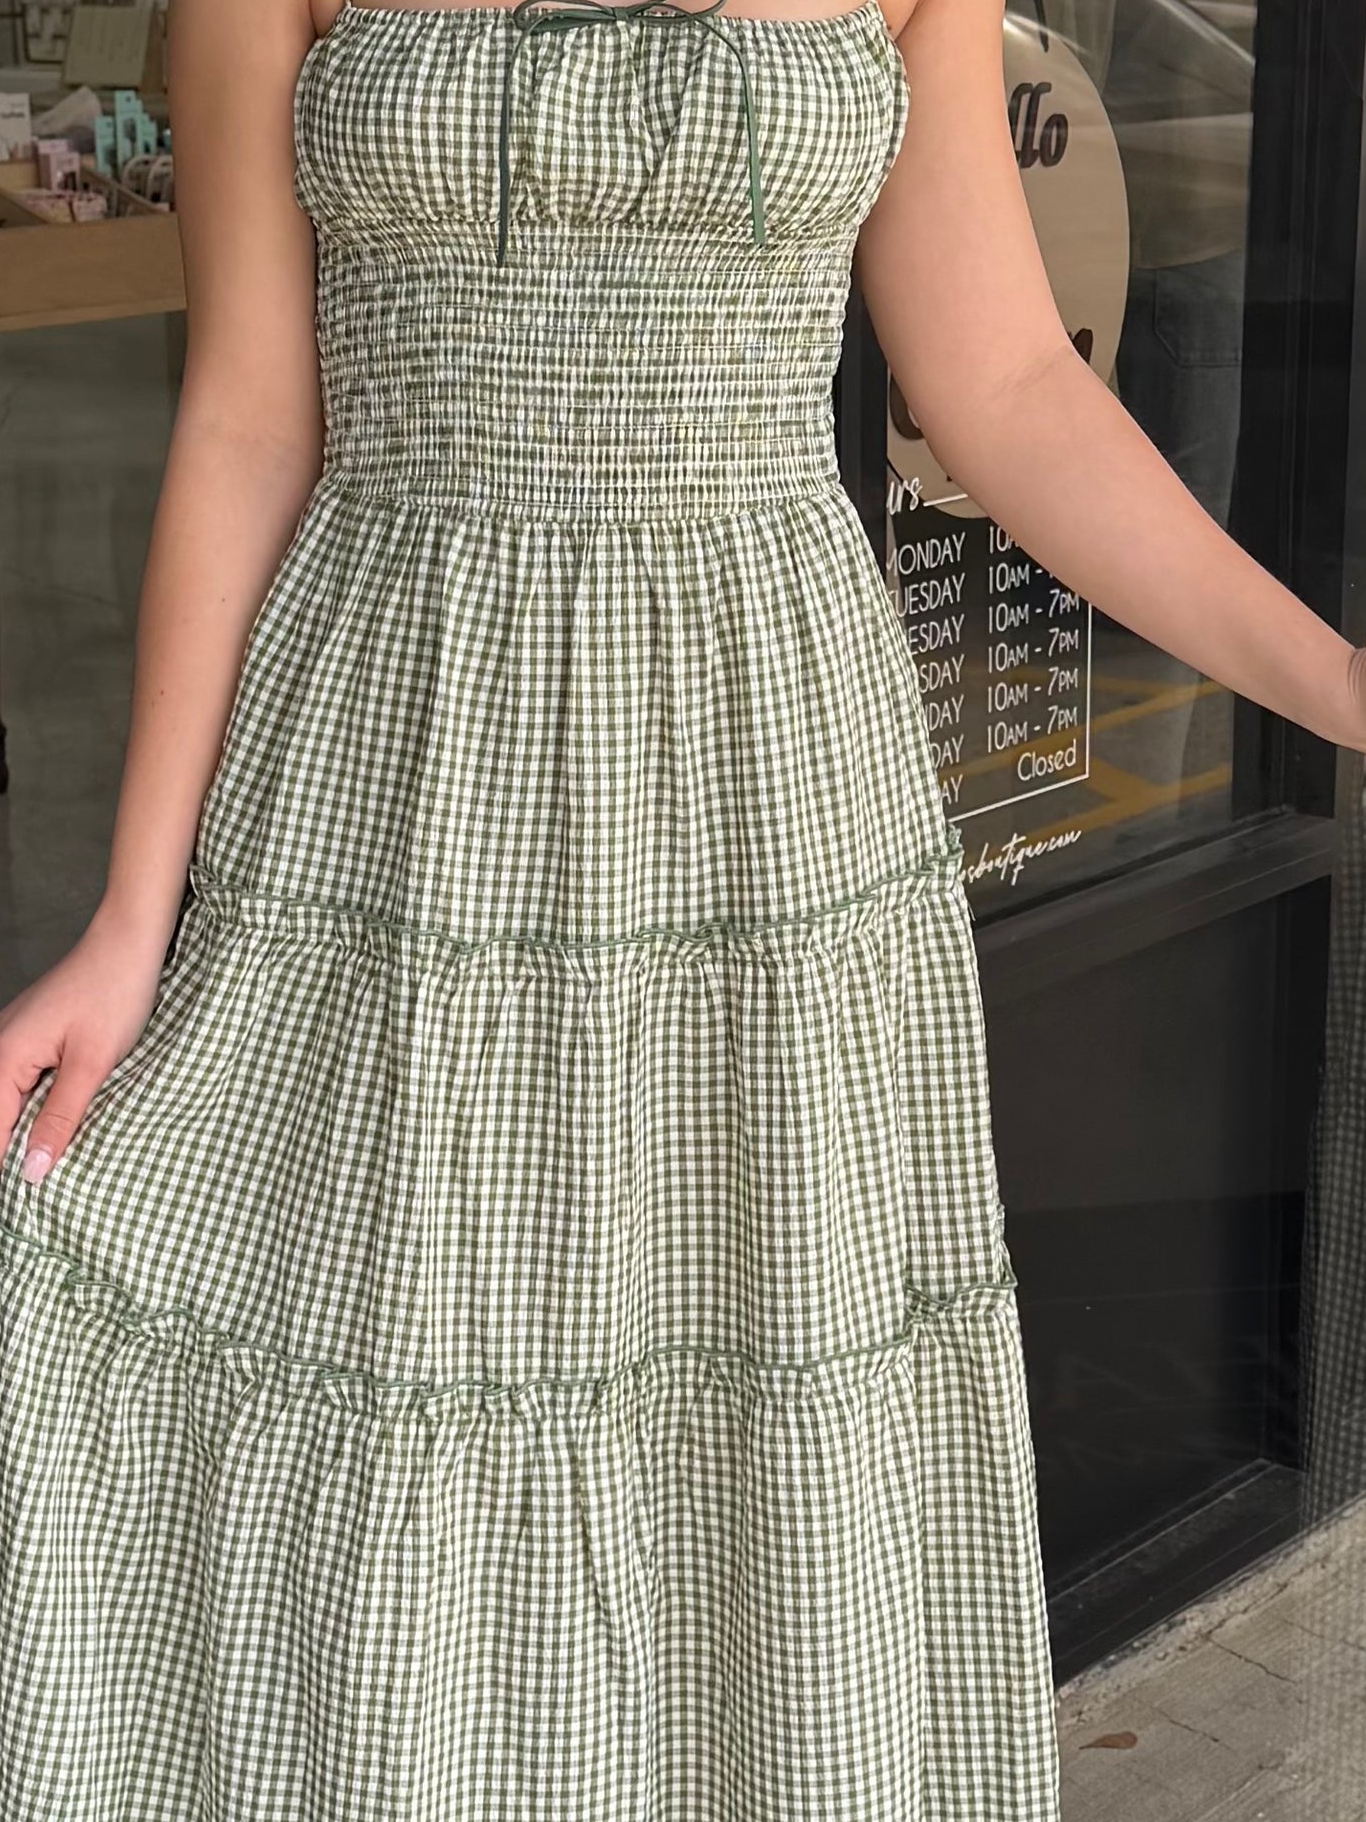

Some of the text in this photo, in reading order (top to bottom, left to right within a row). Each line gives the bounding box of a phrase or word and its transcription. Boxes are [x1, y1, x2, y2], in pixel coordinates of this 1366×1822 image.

[1008, 82, 1069, 169] llo
[886, 477, 923, 516] urs
[989, 563, 1030, 594] 10AM
[906, 614, 965, 656] ESDAY
[988, 603, 1030, 634] 10AM
[1048, 589, 1080, 619] 7PM
[918, 654, 965, 694] SDAY
[988, 642, 1029, 674] 10AM
[1048, 627, 1080, 658] 7PM
[988, 682, 1029, 713] 10AM
[1047, 666, 1079, 697] 7PM
[987, 721, 1028, 754] 10AM
[1047, 705, 1078, 735] 7PM
[1017, 738, 1077, 781] Closed
